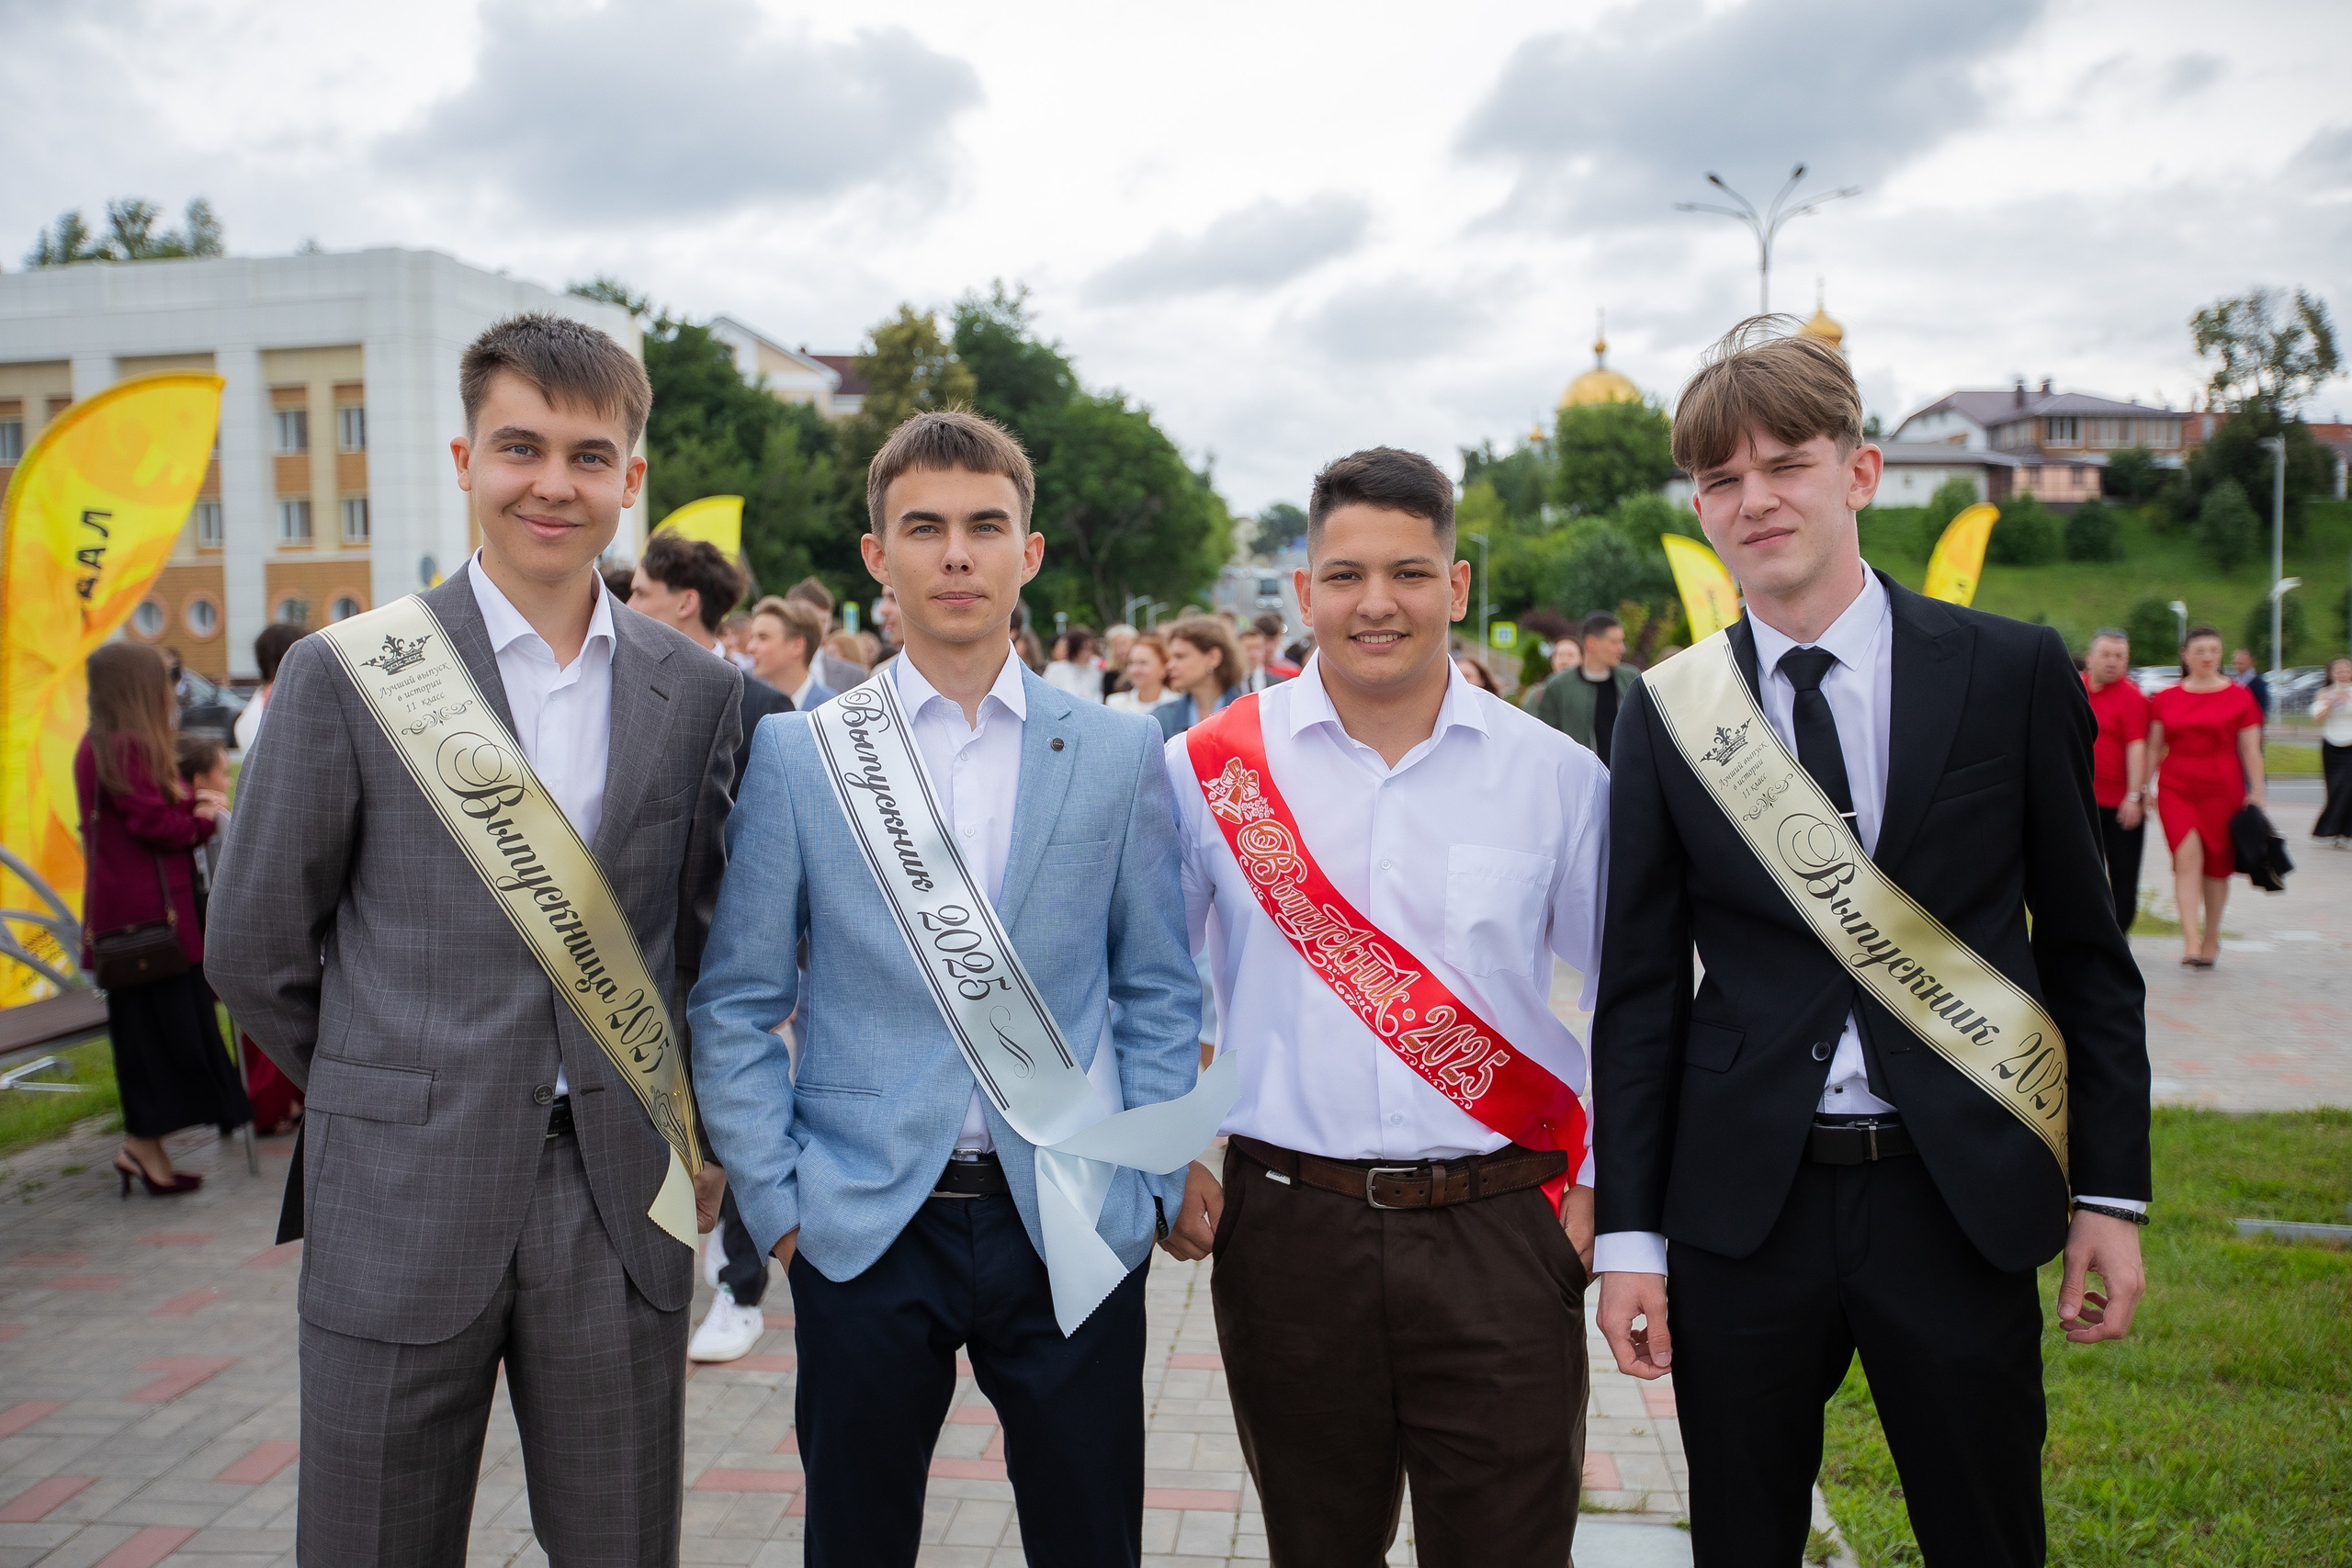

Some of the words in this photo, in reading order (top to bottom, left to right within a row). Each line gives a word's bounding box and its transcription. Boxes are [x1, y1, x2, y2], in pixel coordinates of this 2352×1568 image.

[379, 675, 416, 699] Лучший
[417, 662, 452, 682] выпуск
[403, 679, 442, 698] истории
[406, 702, 417, 713] 11
[421, 692, 445, 706] класс
[1718, 761, 1744, 790] Лучший
[1743, 741, 1770, 765] выпуск
[1736, 759, 1764, 786] истории
[1742, 788, 1751, 799] 11
[1749, 773, 1768, 792] класс
[837, 687, 934, 892] Выпускник
[916, 904, 1012, 1001] 2025
[435, 731, 619, 1004] Выпускница
[605, 988, 670, 1074] 2025
[1237, 818, 1421, 1037] Выпускник
[1396, 1004, 1511, 1100] 2025
[1775, 813, 2000, 1046] Выпускник
[1991, 1032, 2067, 1120] 2025
